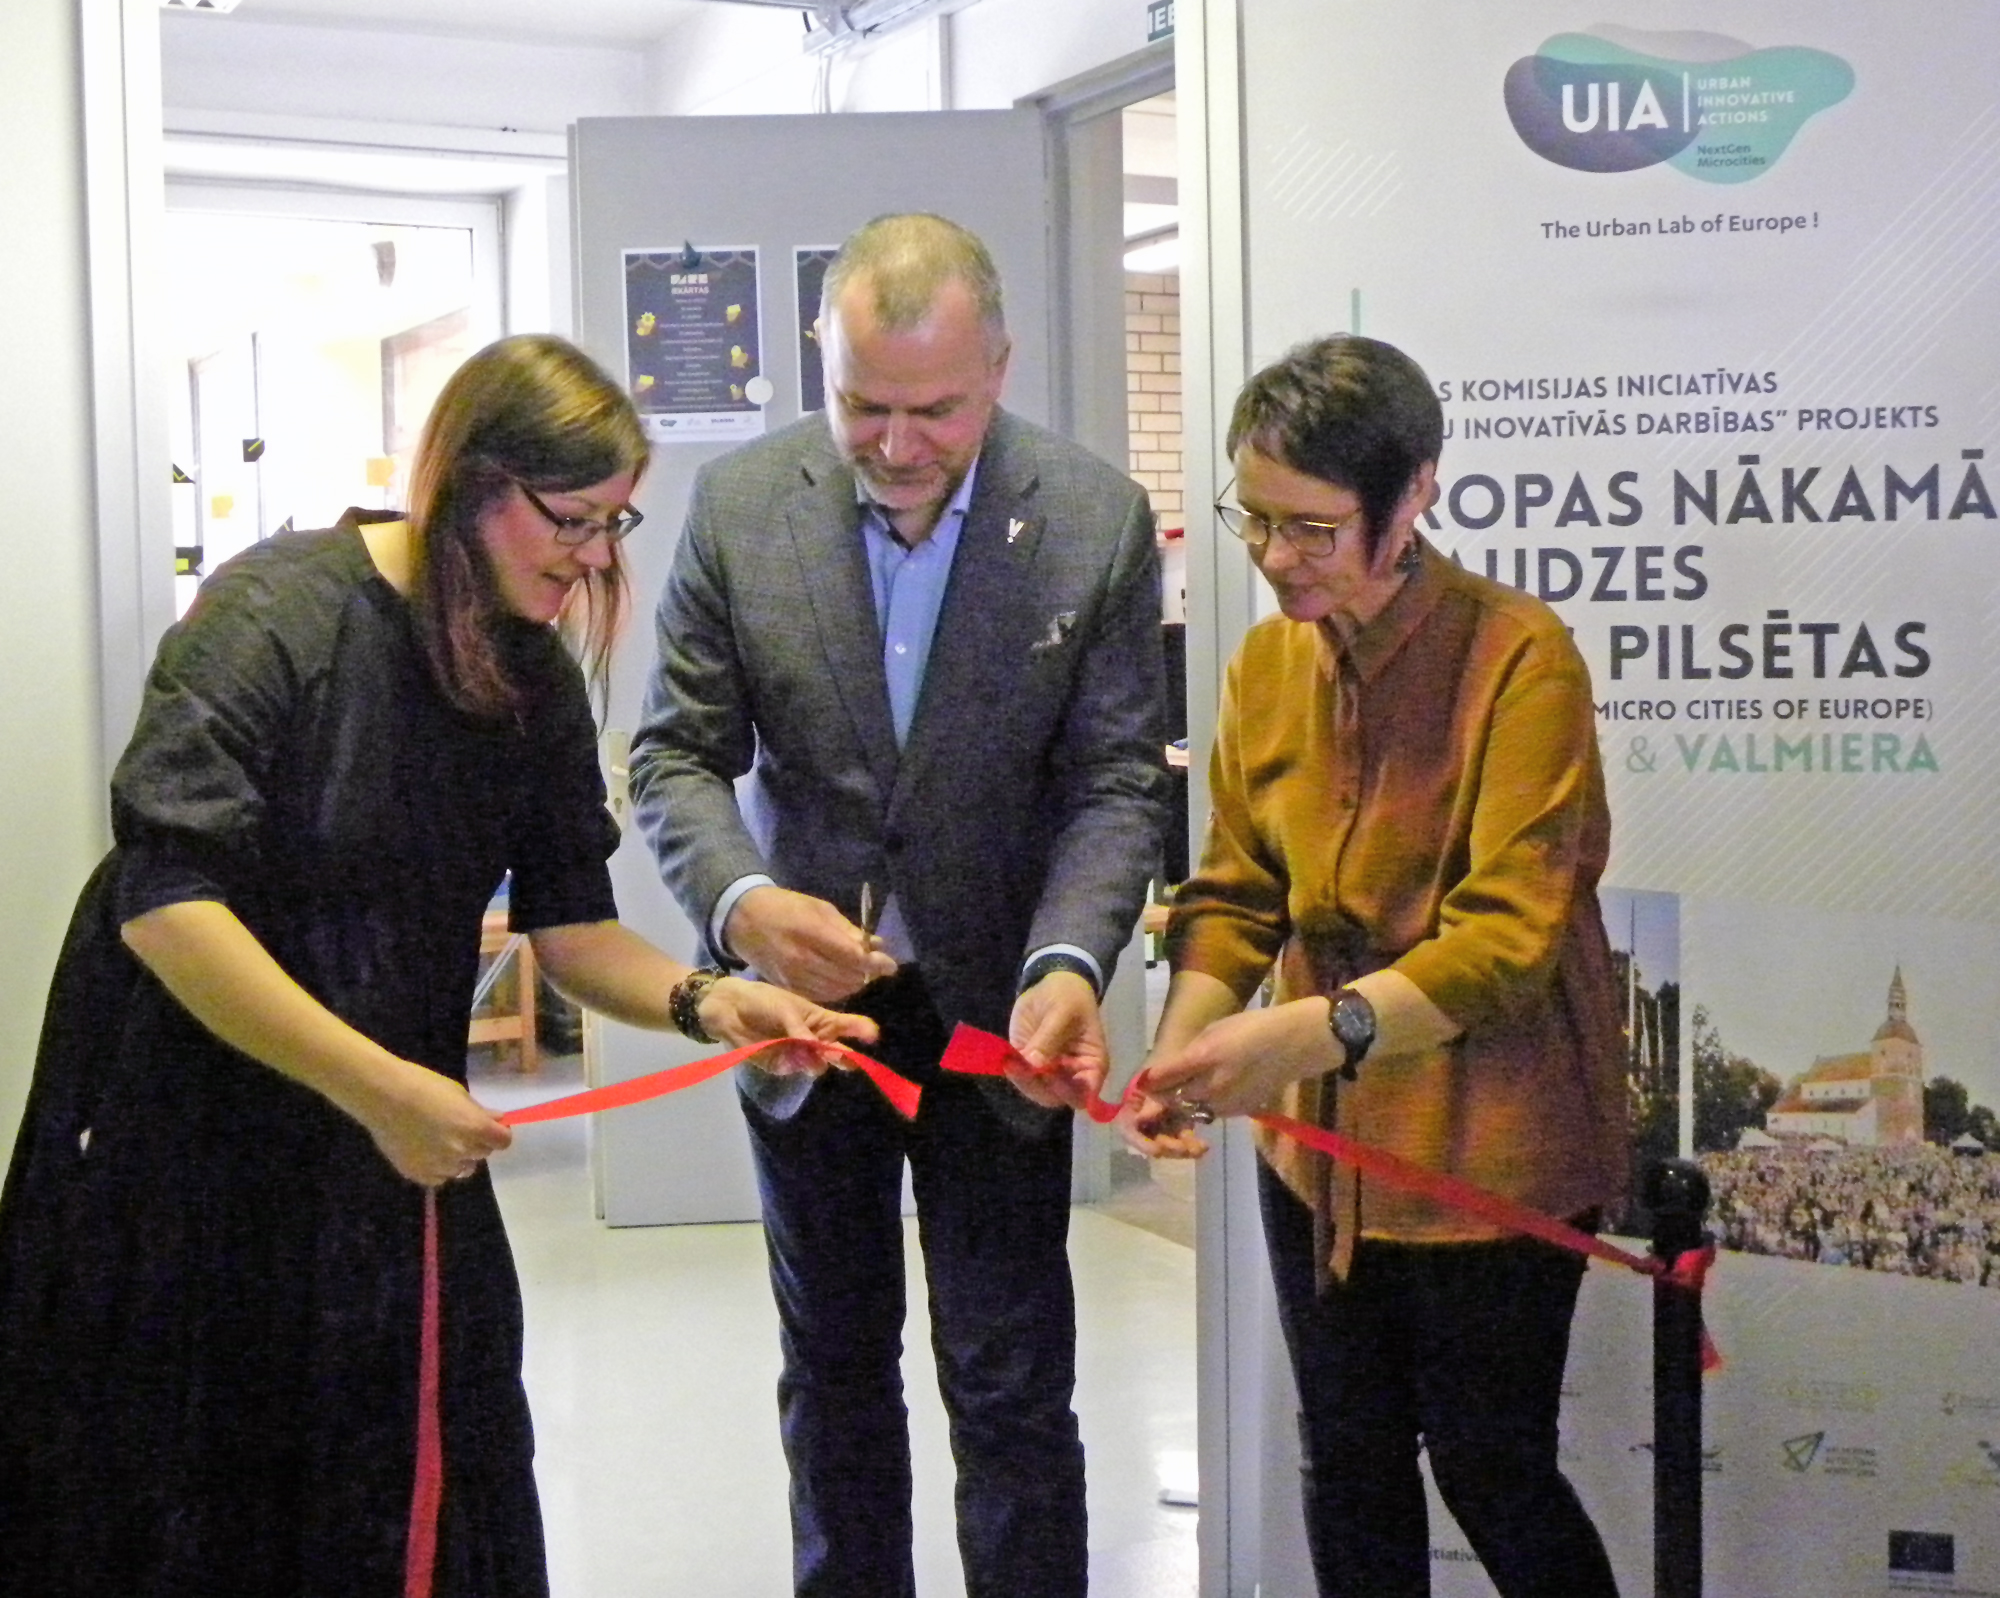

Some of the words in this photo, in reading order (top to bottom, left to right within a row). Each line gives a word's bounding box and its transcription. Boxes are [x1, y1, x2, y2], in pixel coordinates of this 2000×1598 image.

[1697, 76, 1751, 90] URBAN
[1562, 79, 1669, 133] UIA
[1697, 90, 1794, 108] INNOVATIVE
[1697, 110, 1768, 126] ACTIONS
[1697, 144, 1751, 155] NextGen
[1697, 156, 1766, 167] Microcities
[1541, 221, 1580, 239] The
[1587, 218, 1650, 237] Urban
[1658, 215, 1695, 234] Lab
[1701, 213, 1724, 233] of
[1729, 214, 1807, 234] Europe
[1462, 376, 1607, 402] KOMISIJAS
[1618, 367, 1778, 397] INICIATĪVAS
[1465, 409, 1627, 440] INOVATĪVĀS
[1798, 405, 1939, 431] PROJEKTS
[1673, 449, 1998, 526] NĀKAMĀ
[1610, 609, 1931, 680] PILSĒTAS
[1687, 699, 1763, 721] CITIES
[1773, 698, 1809, 720] OF
[1819, 698, 1933, 721] EUROPE)
[1625, 735, 1657, 773] &
[1675, 732, 1940, 773] VALMIERA
